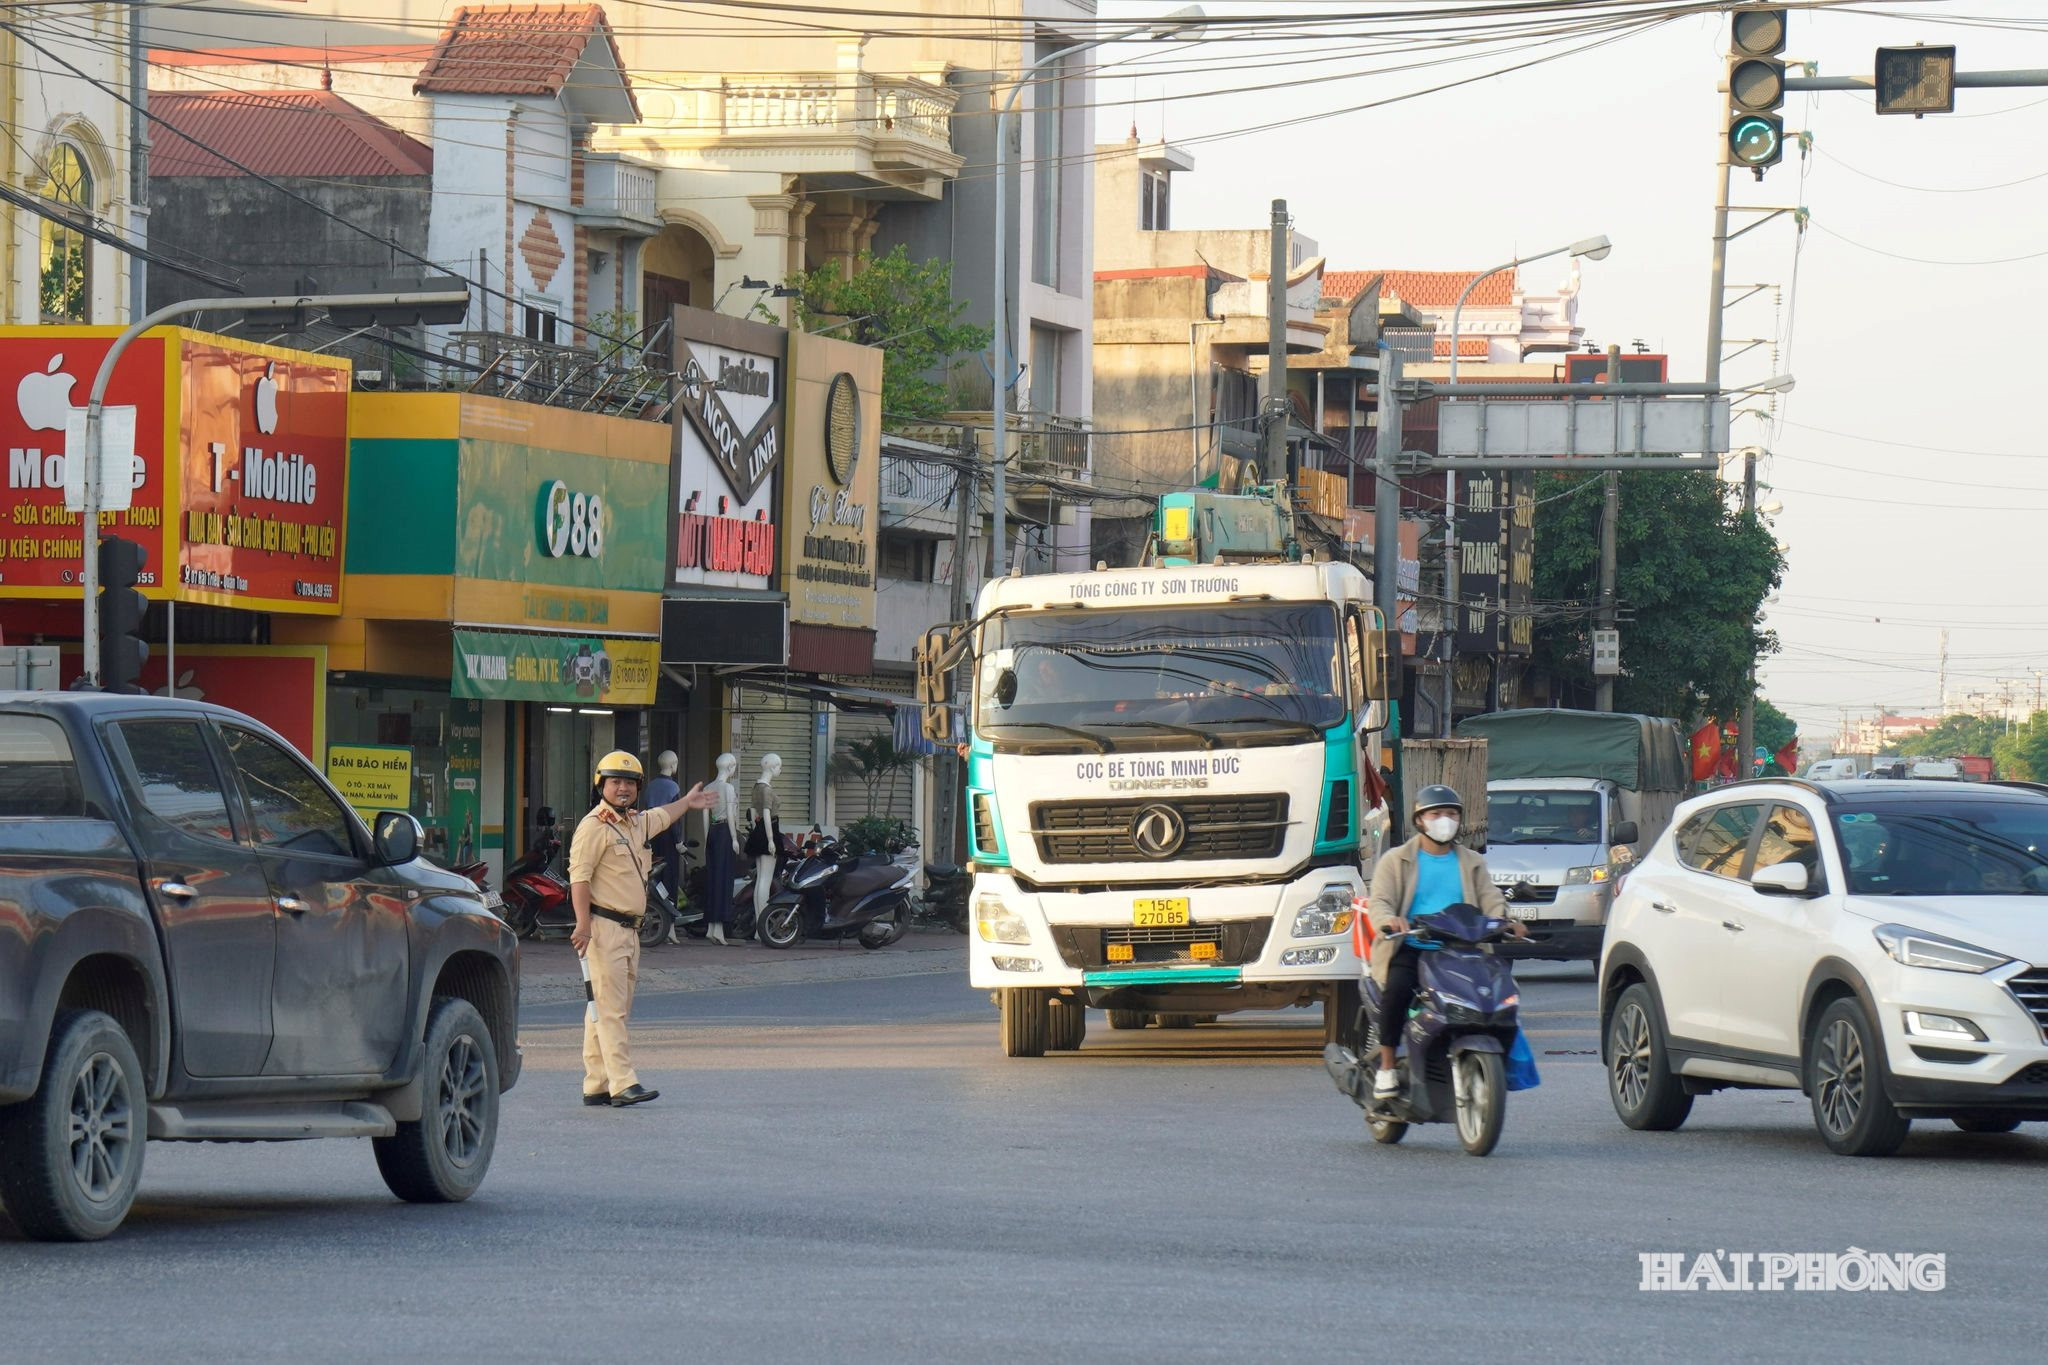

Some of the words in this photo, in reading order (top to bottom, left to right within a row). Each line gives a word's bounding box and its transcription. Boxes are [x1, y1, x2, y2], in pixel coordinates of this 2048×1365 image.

[718, 355, 770, 398] Fashion
[703, 390, 740, 470] NGỌC
[748, 426, 777, 485] LINH
[213, 442, 225, 492] T
[245, 447, 316, 505] Mobile
[1469, 471, 1493, 512] THỜI
[13, 498, 38, 525] SỬA
[124, 506, 160, 529] THOẠI
[188, 511, 205, 542] MUA
[207, 506, 223, 544] BÁN
[227, 505, 241, 547] SỬA
[243, 512, 261, 549] CHỮA
[263, 513, 280, 557] ĐIỆN
[281, 522, 300, 559] THOẠI
[304, 524, 318, 560] PHỤ
[319, 520, 335, 561] KIỆN
[678, 490, 704, 568] MỐT
[706, 495, 743, 574] QUẢNG
[744, 509, 775, 577] CHÂU
[10, 536, 39, 562] KIỆN
[42, 535, 82, 559] CHÍNH
[1462, 541, 1498, 575] TRANG
[1070, 579, 1100, 598] TỔNG
[1105, 579, 1137, 597] CÔNG
[1142, 581, 1155, 595] TY
[1162, 579, 1186, 594] SƠN
[480, 655, 507, 680] NHANH
[516, 652, 537, 681] ĐĂNG
[550, 658, 559, 682] XE
[462, 723, 481, 737] nhanh
[332, 756, 354, 768] BÁN
[356, 756, 379, 769] BẢO
[382, 756, 408, 771] HIỂM
[1077, 762, 1104, 783] CỌC
[1108, 758, 1125, 778] BÊ
[1130, 758, 1165, 777] TÔNG
[1171, 759, 1208, 777] MINH
[1212, 753, 1239, 775] ĐỨC
[353, 781, 362, 789] TÔ
[376, 781, 392, 790] MÁY
[1109, 777, 1209, 791] DONGFENG
[1140, 911, 1184, 925] 270.85
[1151, 900, 1174, 911] 15C
